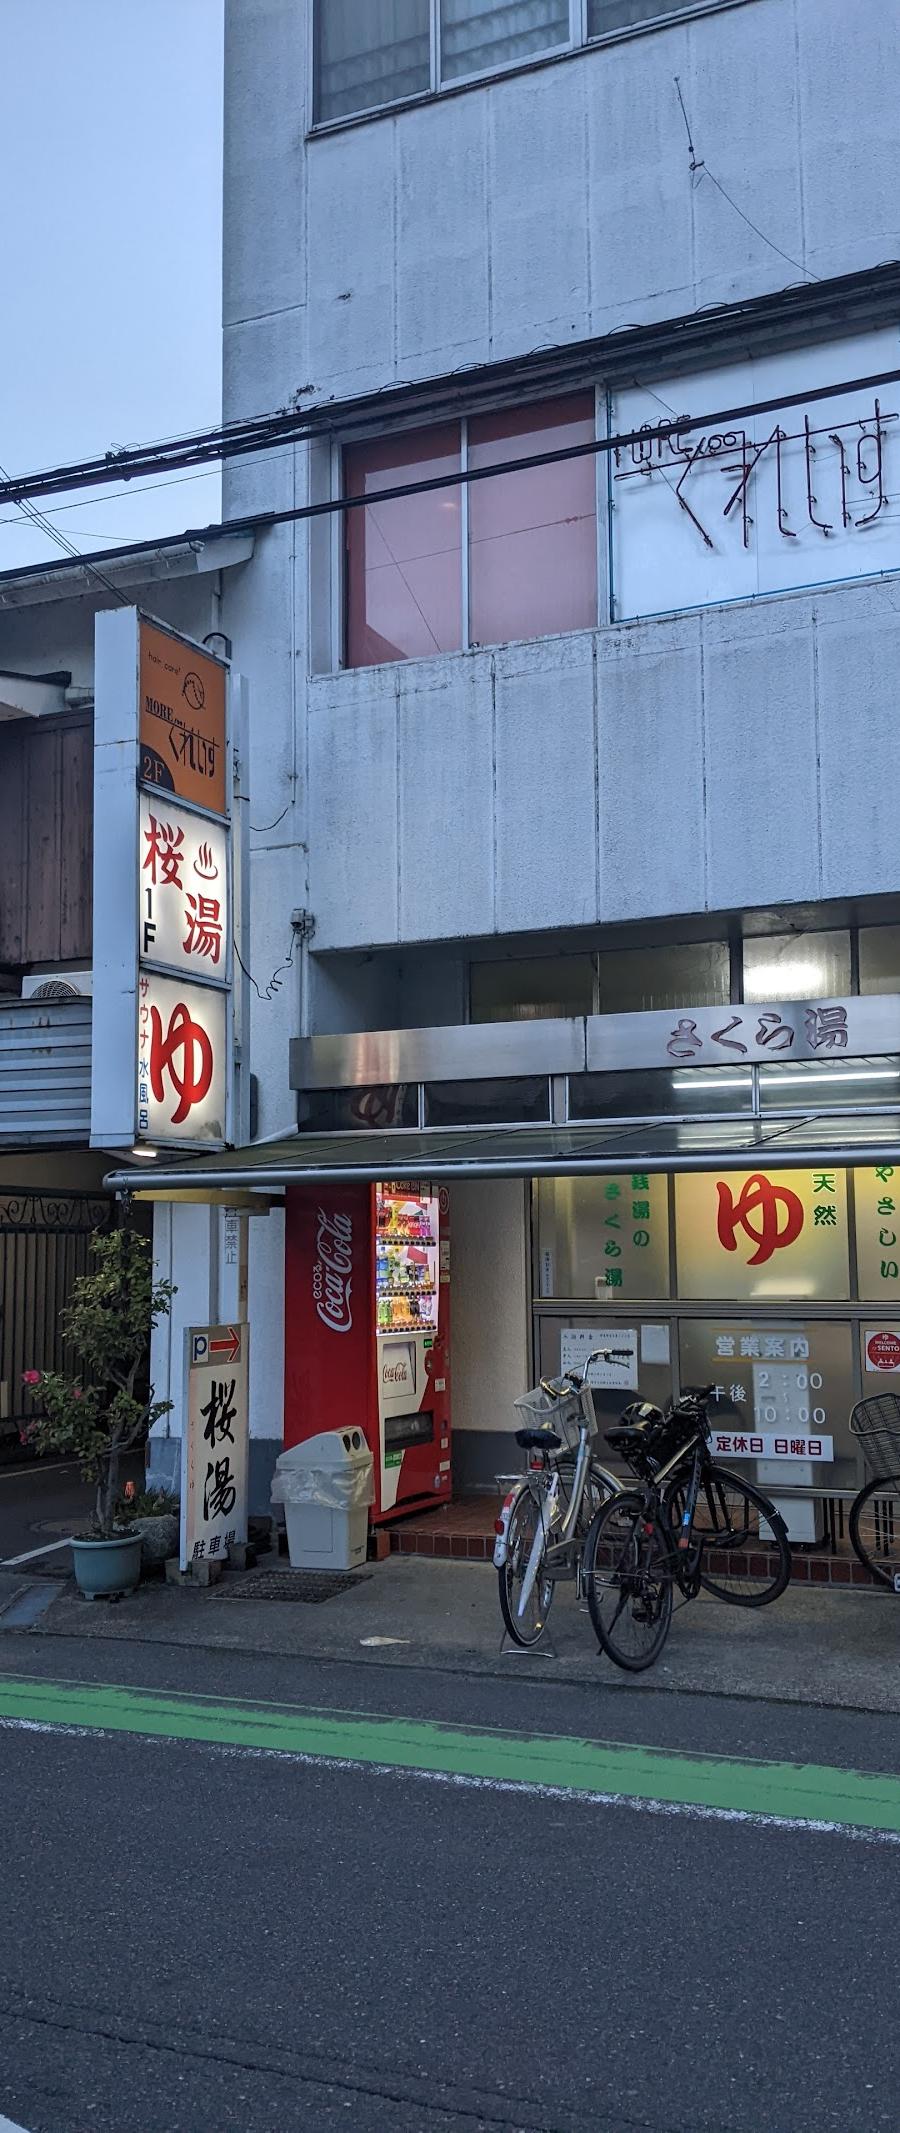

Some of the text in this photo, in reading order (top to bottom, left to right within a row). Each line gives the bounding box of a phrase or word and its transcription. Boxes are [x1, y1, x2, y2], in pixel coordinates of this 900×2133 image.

[145, 696, 173, 722] MORE
[144, 756, 164, 782] 2F
[143, 813, 223, 965] 桜湯
[143, 887, 157, 953] 1F
[666, 1006, 849, 1058] さくら湯
[150, 1002, 213, 1124] ゆ
[716, 1173, 805, 1265] ゆ
[812, 1173, 837, 1226] 天然
[875, 1166, 899, 1279] やさしい
[604, 1182, 623, 1288] さくら湯
[316, 1206, 353, 1333] Coca-Cola
[716, 1335, 810, 1357] 営業案内
[710, 1383, 747, 1403] 午後
[200, 1378, 238, 1521] 桜湯
[716, 1436, 822, 1456] 定休日 日曜日
[191, 1530, 237, 1561] 駐車場
